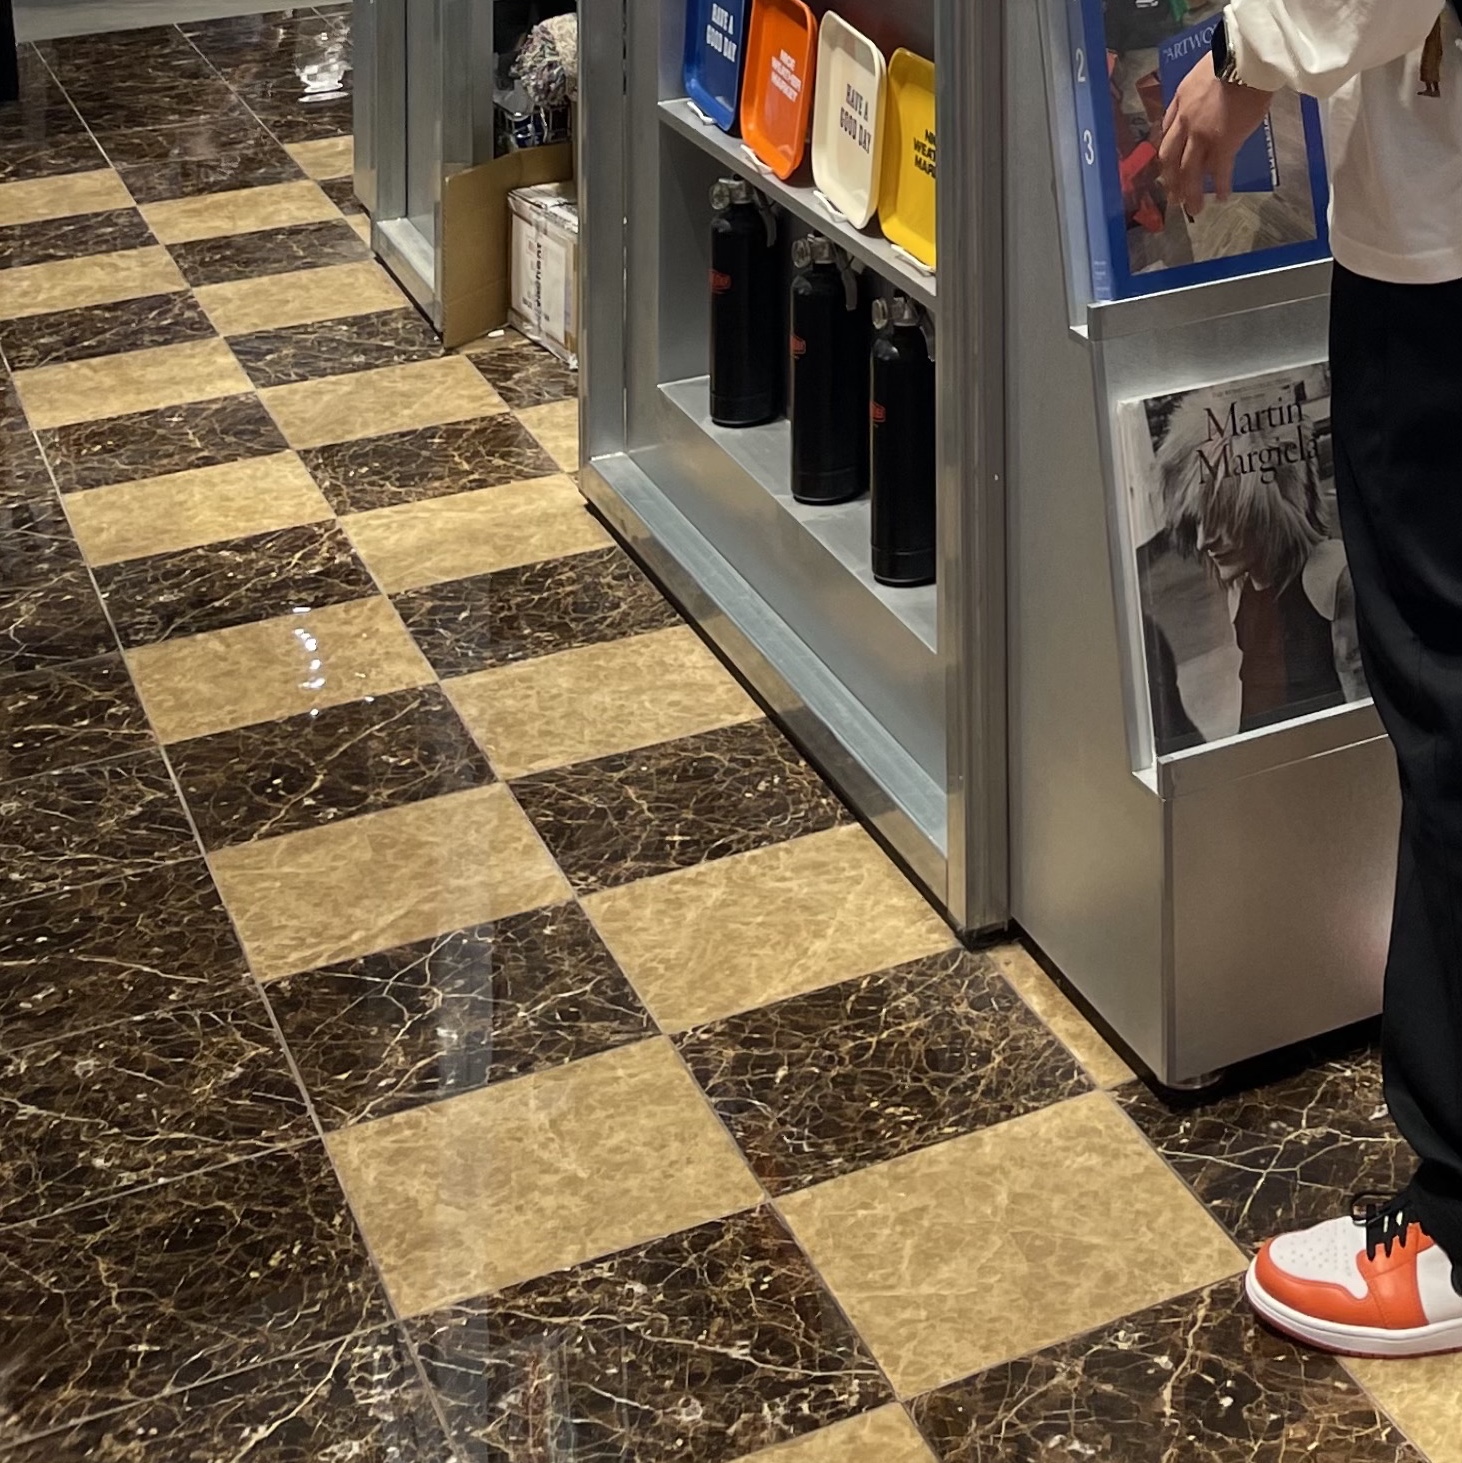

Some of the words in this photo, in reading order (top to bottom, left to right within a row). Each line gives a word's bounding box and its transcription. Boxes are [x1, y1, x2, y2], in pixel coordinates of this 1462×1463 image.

[711, 3, 729, 32] HAVE
[728, 15, 734, 36] A
[722, 36, 737, 63] DAY
[1075, 47, 1087, 83] 2
[845, 83, 864, 117] HAVE
[863, 101, 869, 122] A
[858, 124, 872, 155] DAY
[913, 137, 936, 163] WEAT
[1083, 130, 1095, 165] 3
[1203, 396, 1304, 442] Martin
[1196, 425, 1319, 485] Margiela
